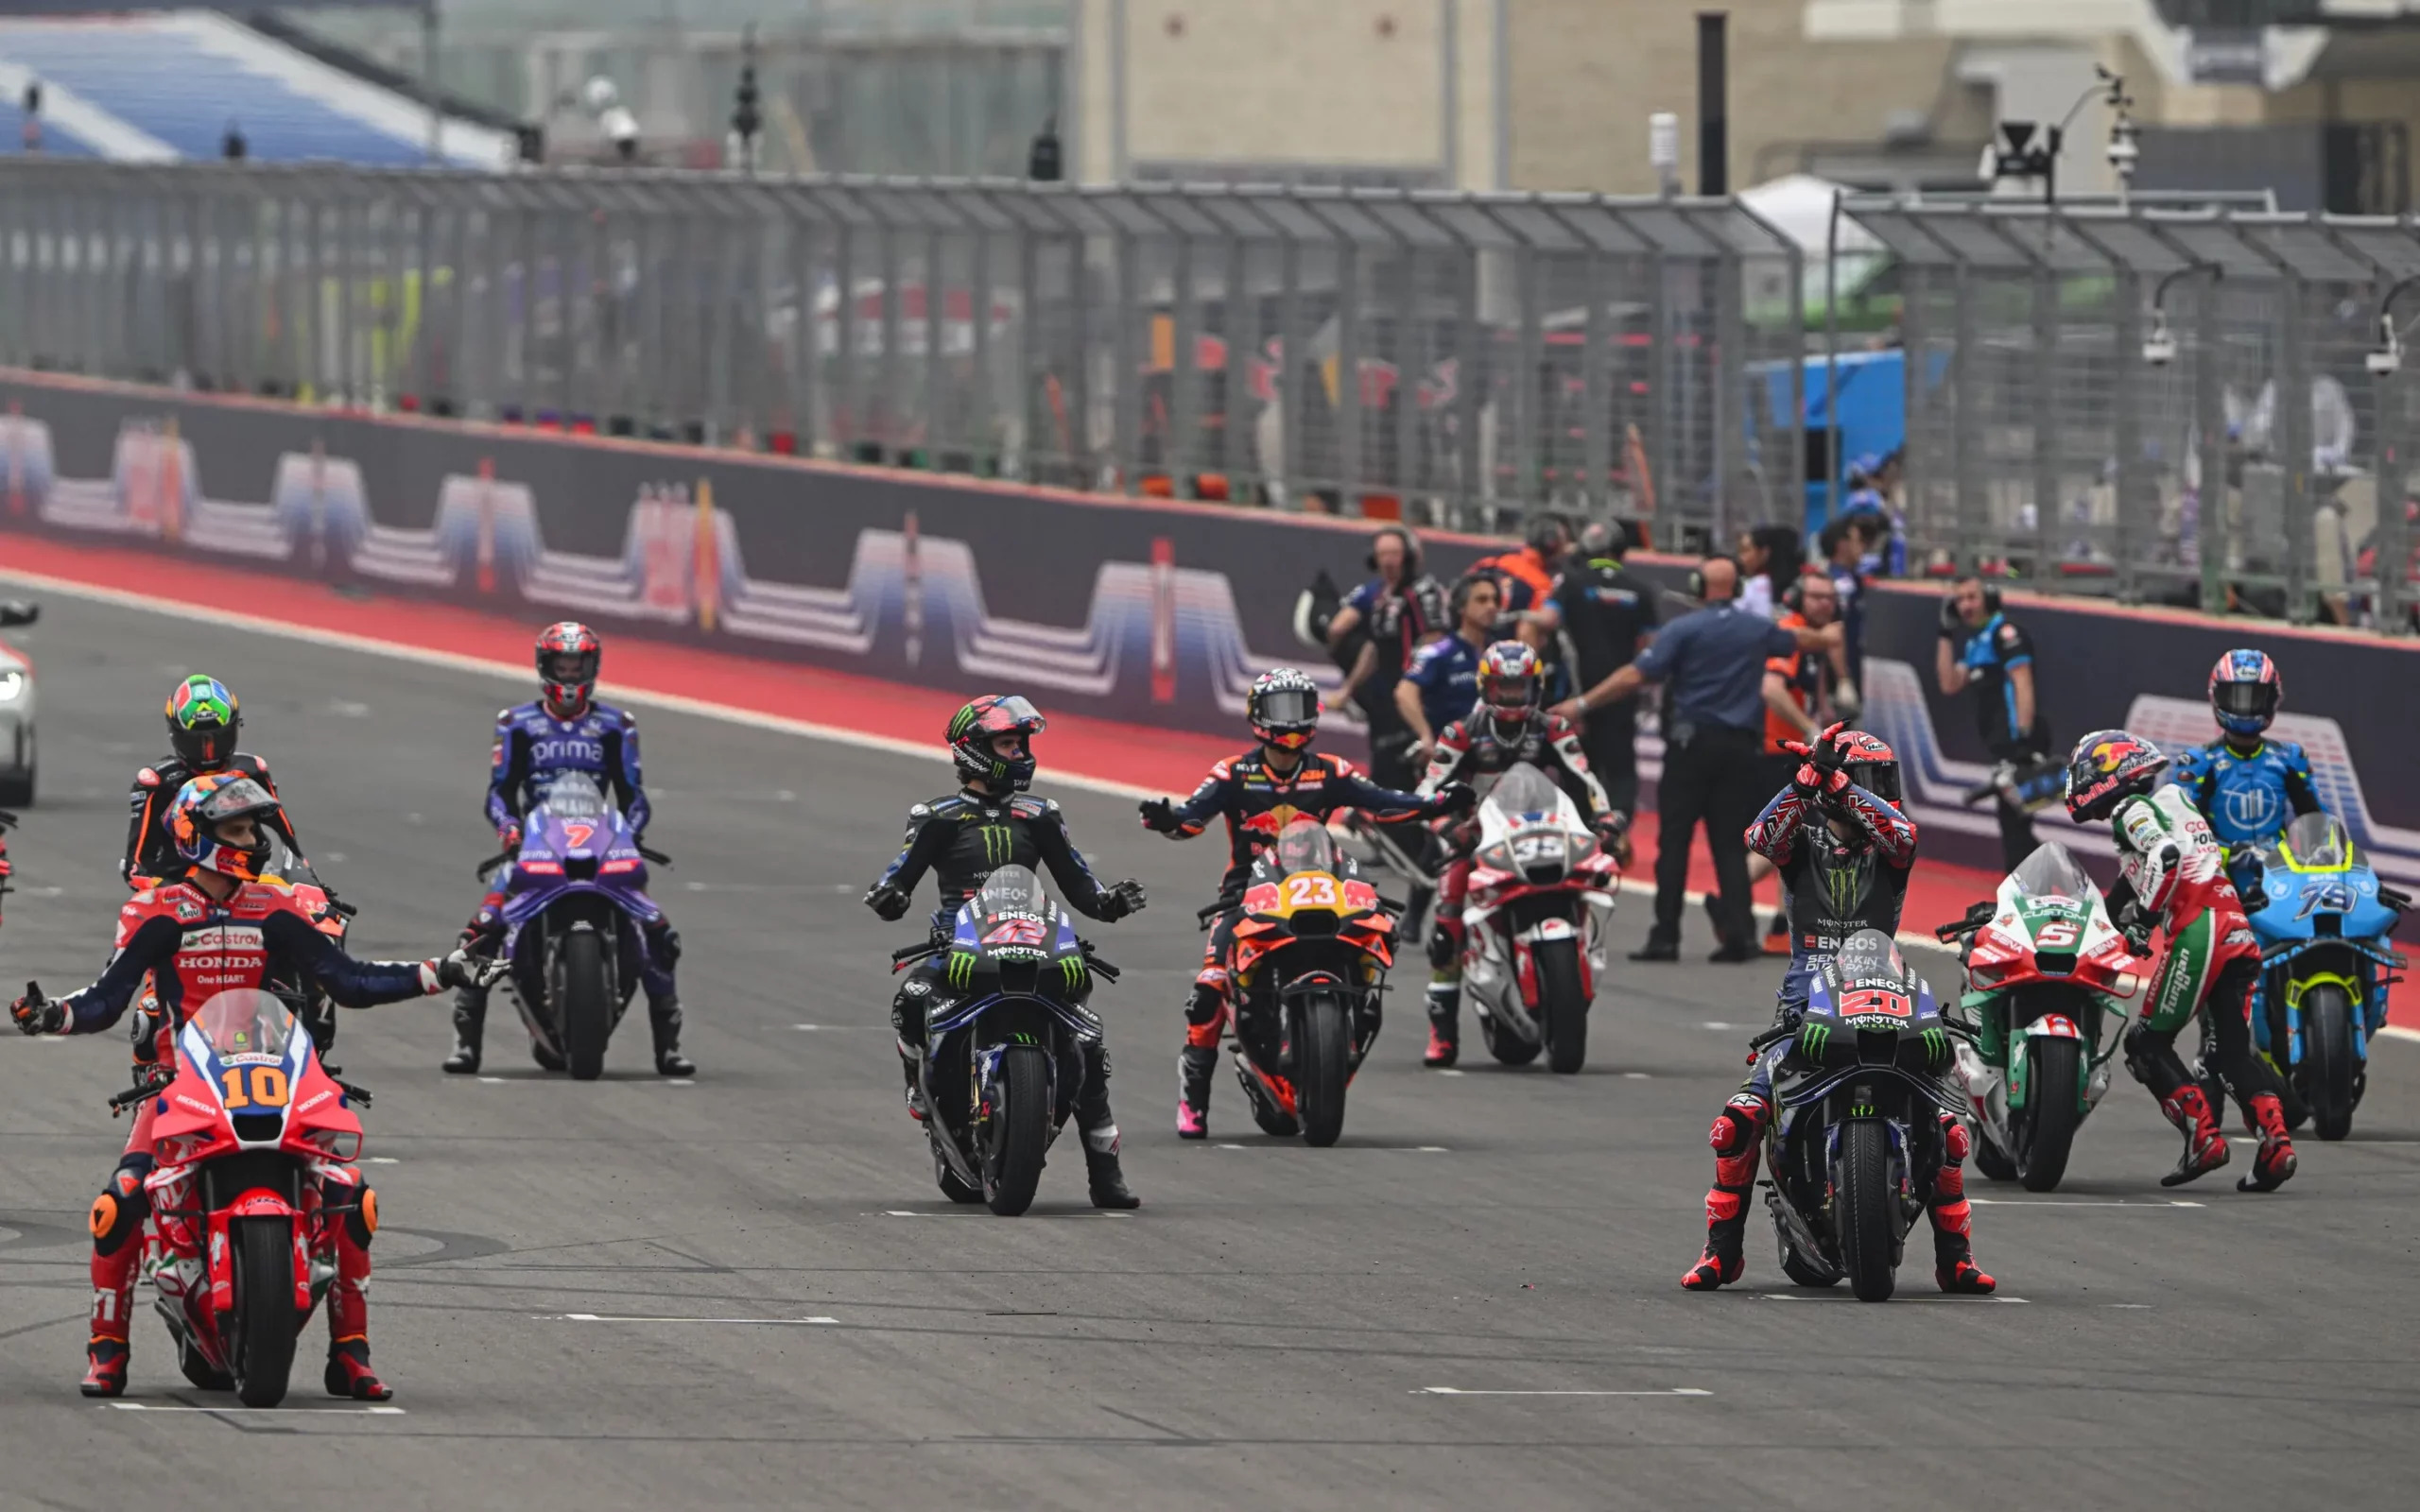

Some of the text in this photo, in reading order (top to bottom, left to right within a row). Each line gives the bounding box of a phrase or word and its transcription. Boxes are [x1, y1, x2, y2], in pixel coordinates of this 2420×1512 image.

[530, 740, 604, 766] prima
[564, 824, 595, 849] 7
[977, 887, 1028, 901] NEOS
[1288, 877, 1337, 906] 23
[998, 911, 1045, 926] ENEOS
[2022, 908, 2088, 922] CUSTOM
[1817, 918, 1869, 928] MONSTER
[200, 933, 260, 945] Castrol
[980, 919, 1048, 946] 42
[1817, 936, 1878, 951] ENEOS
[1989, 931, 2023, 954] SENA
[2087, 938, 2119, 959] SENA
[987, 946, 1049, 959] MONSTER
[178, 956, 263, 969] HONDA
[197, 975, 215, 985] One
[1856, 978, 1905, 993] ENEOS
[1839, 988, 1912, 1018] 20
[1844, 1014, 1910, 1029] MONSTER
[235, 1054, 281, 1064] Castrol
[220, 1064, 290, 1110] 10
[176, 1093, 217, 1117] HONDA
[297, 1091, 334, 1113] HONDA
